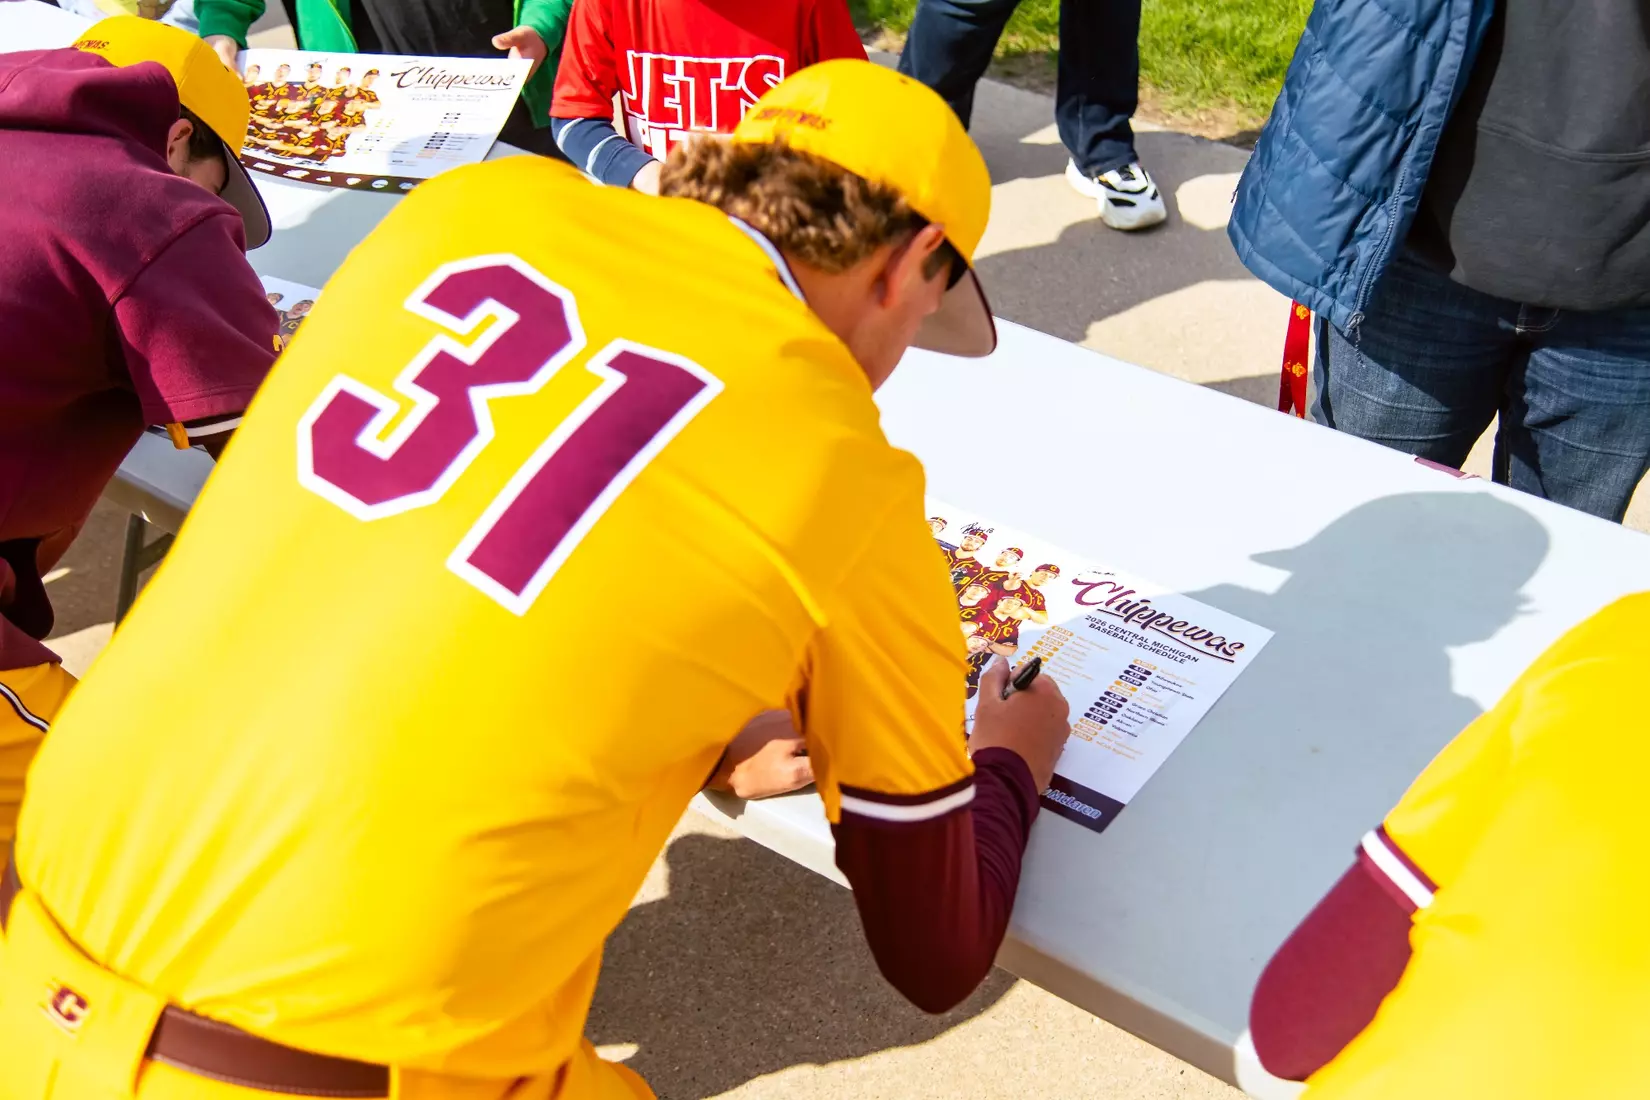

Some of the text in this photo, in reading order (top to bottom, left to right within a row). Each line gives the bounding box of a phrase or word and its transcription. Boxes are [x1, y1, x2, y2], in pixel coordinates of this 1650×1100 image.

[391, 66, 515, 89] Chippewas
[622, 50, 784, 131] JET'S
[297, 253, 725, 616] 31
[1072, 578, 1245, 657] Chippewas
[1085, 614, 1107, 628] 2026
[1108, 624, 1149, 644] CENTRAL
[1152, 640, 1199, 663] MICHIGAN
[1088, 622, 1134, 645] BASEBALL
[1136, 641, 1187, 665] SCHEDULE
[1047, 790, 1102, 820] McLaren
